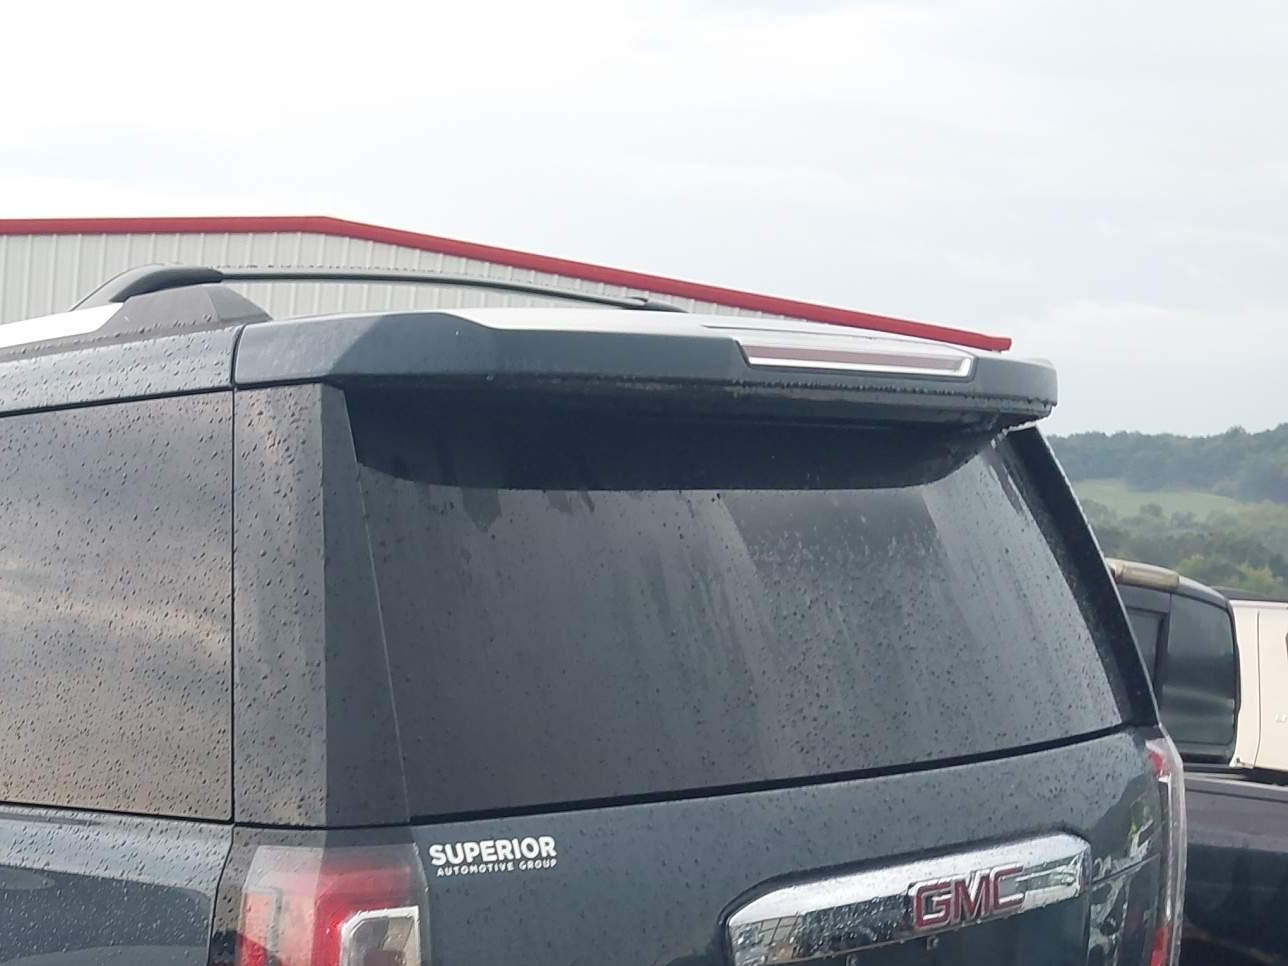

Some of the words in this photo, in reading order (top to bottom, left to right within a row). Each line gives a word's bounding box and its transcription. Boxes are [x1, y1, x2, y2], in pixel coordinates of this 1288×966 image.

[429, 836, 557, 866] SUPERIOR
[436, 862, 514, 877] AUTOMOTIVE
[518, 859, 557, 871] GROUP
[909, 862, 1025, 930] GMC
